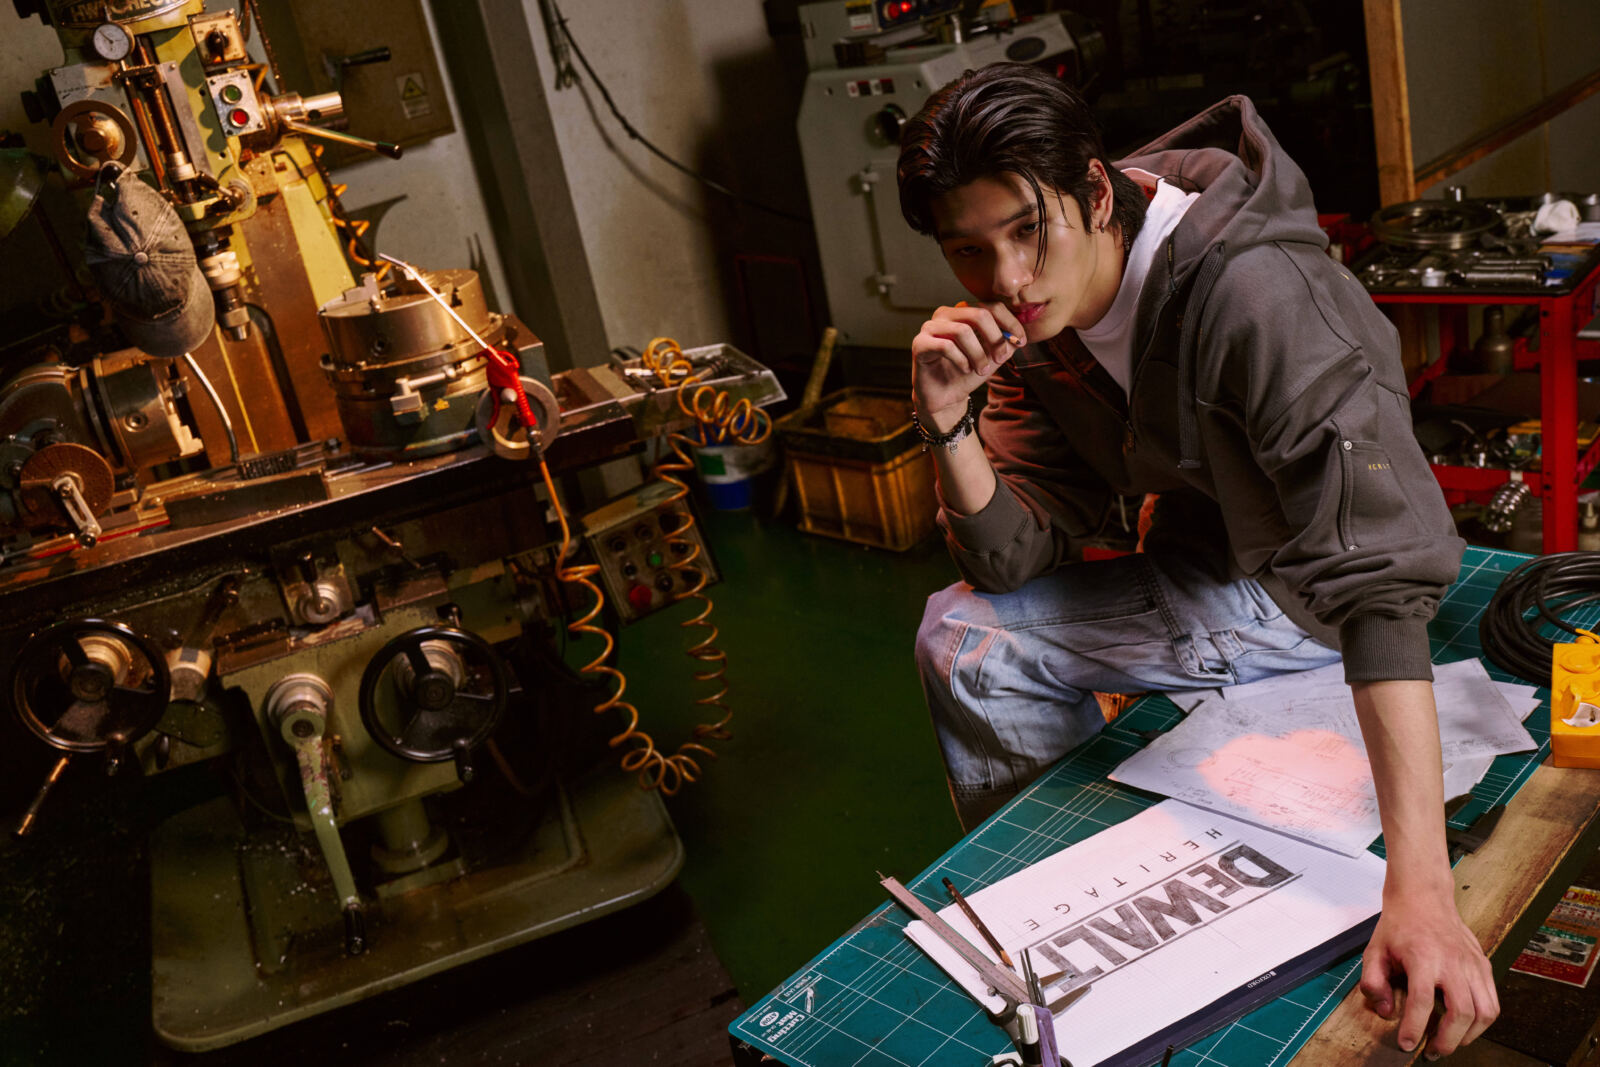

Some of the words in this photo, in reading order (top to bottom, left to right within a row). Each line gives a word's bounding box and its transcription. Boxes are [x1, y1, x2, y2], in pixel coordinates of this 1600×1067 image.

[1023, 828, 1223, 931] HERITAGE
[1035, 843, 1295, 993] DEWALT
[1247, 973, 1271, 989] OXFORD
[767, 1014, 806, 1043] Cutting
[776, 1010, 798, 1026] Mat
